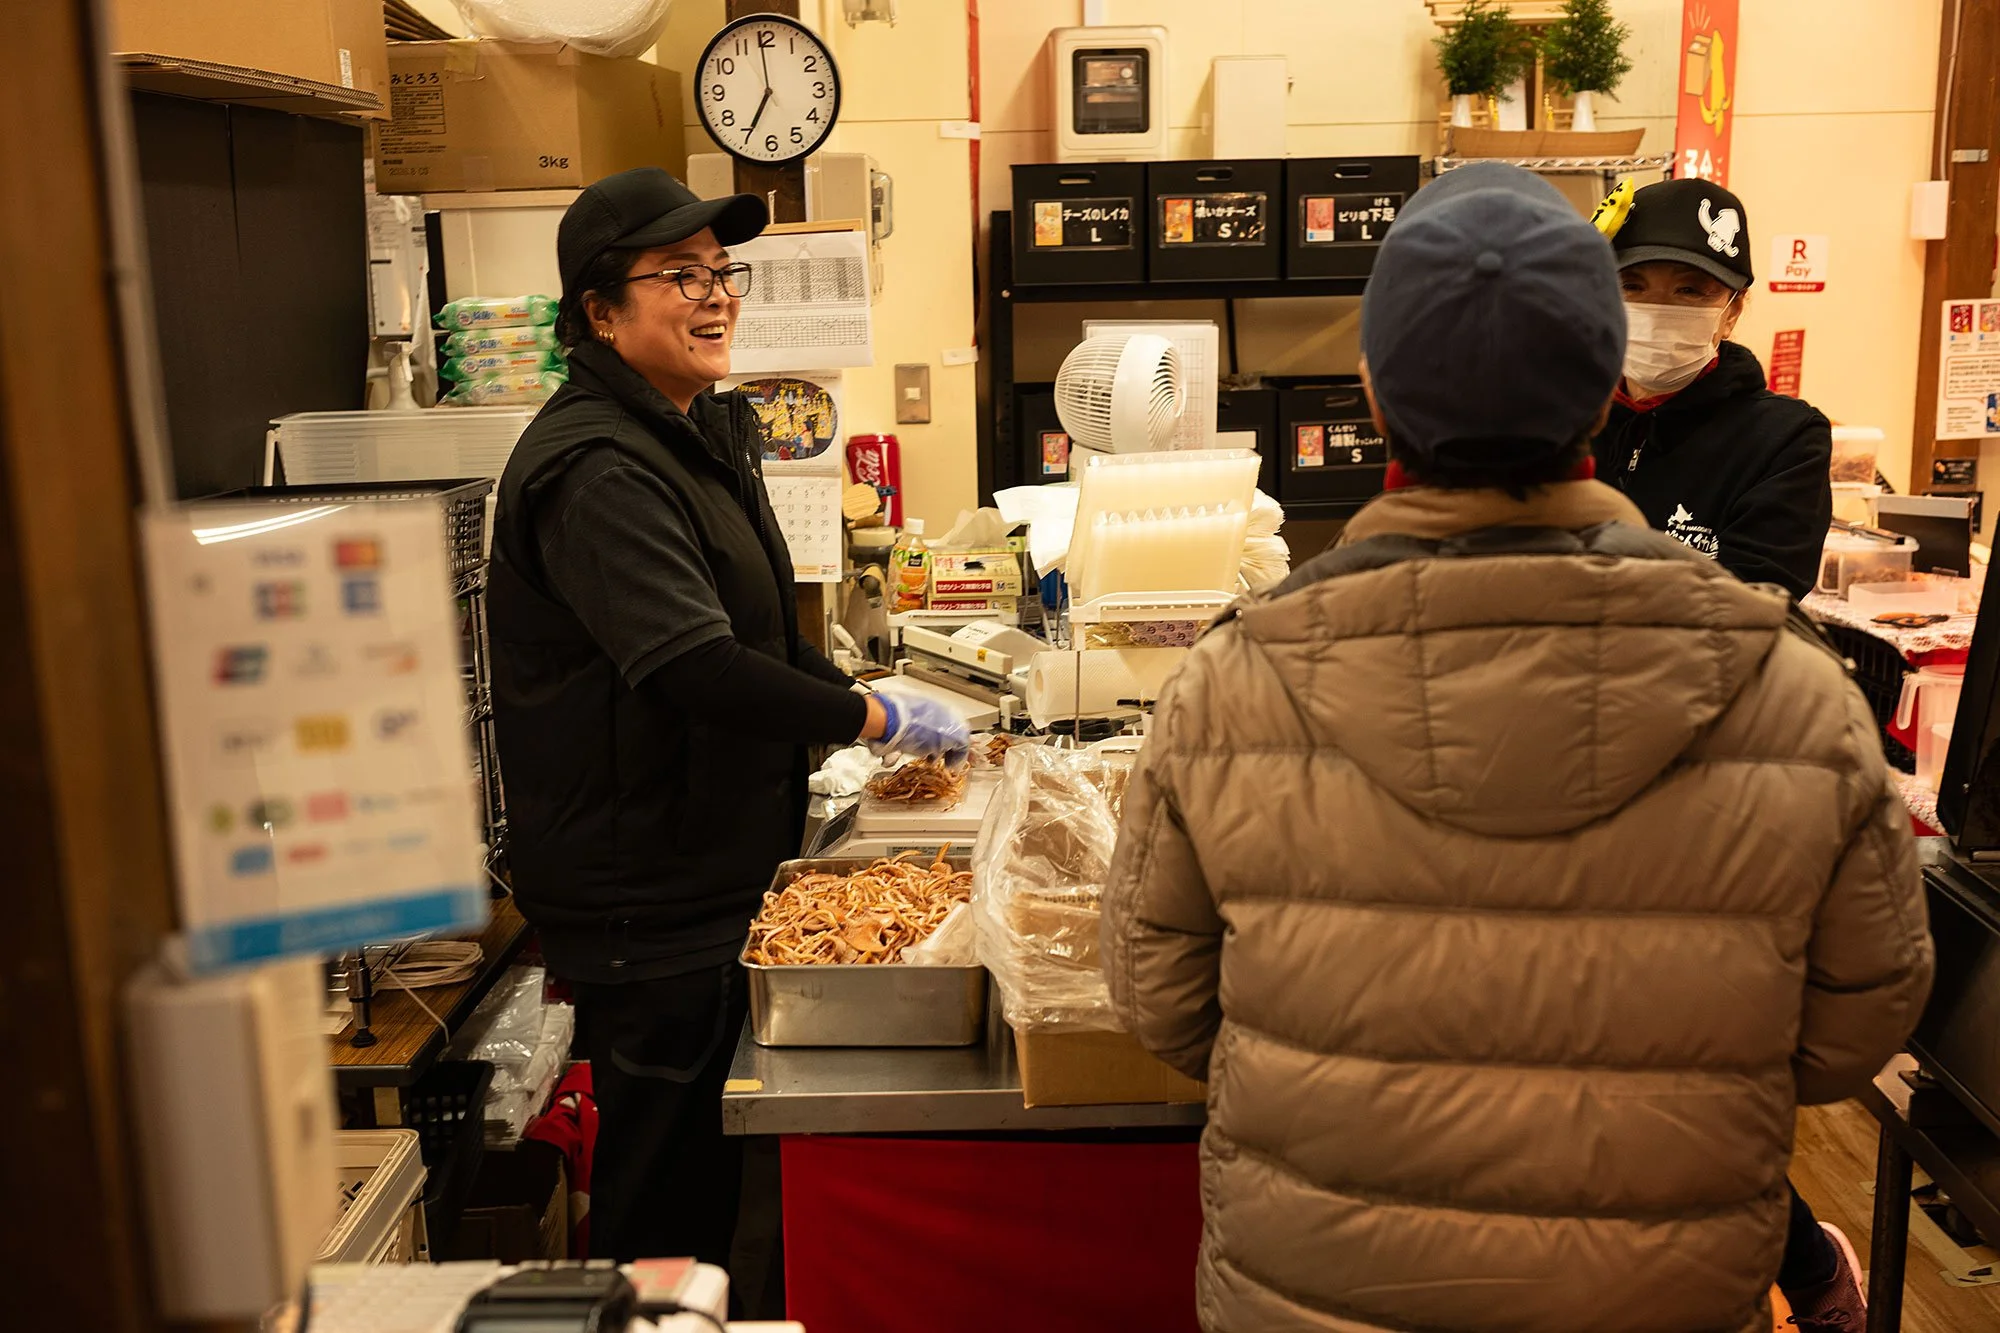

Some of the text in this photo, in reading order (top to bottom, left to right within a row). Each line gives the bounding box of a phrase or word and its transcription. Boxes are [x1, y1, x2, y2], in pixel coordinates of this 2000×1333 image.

[735, 38, 749, 56] 11
[757, 30, 776, 48] 12
[790, 37, 795, 55] 1
[716, 57, 735, 75] 10
[803, 55, 817, 73] 2
[712, 84, 725, 102] 9
[812, 82, 826, 99] 3
[721, 109, 735, 127] 8
[805, 107, 819, 125] 4
[740, 127, 754, 145] 7
[765, 134, 779, 152] 6
[790, 127, 803, 144] 5
[538, 155, 569, 169] 3kg
[1091, 227, 1102, 242] L
[1220, 222, 1232, 238] S
[1361, 224, 1373, 240] L
[1792, 239, 1807, 259] R
[1785, 265, 1811, 279] Pay
[1351, 448, 1363, 463] S
